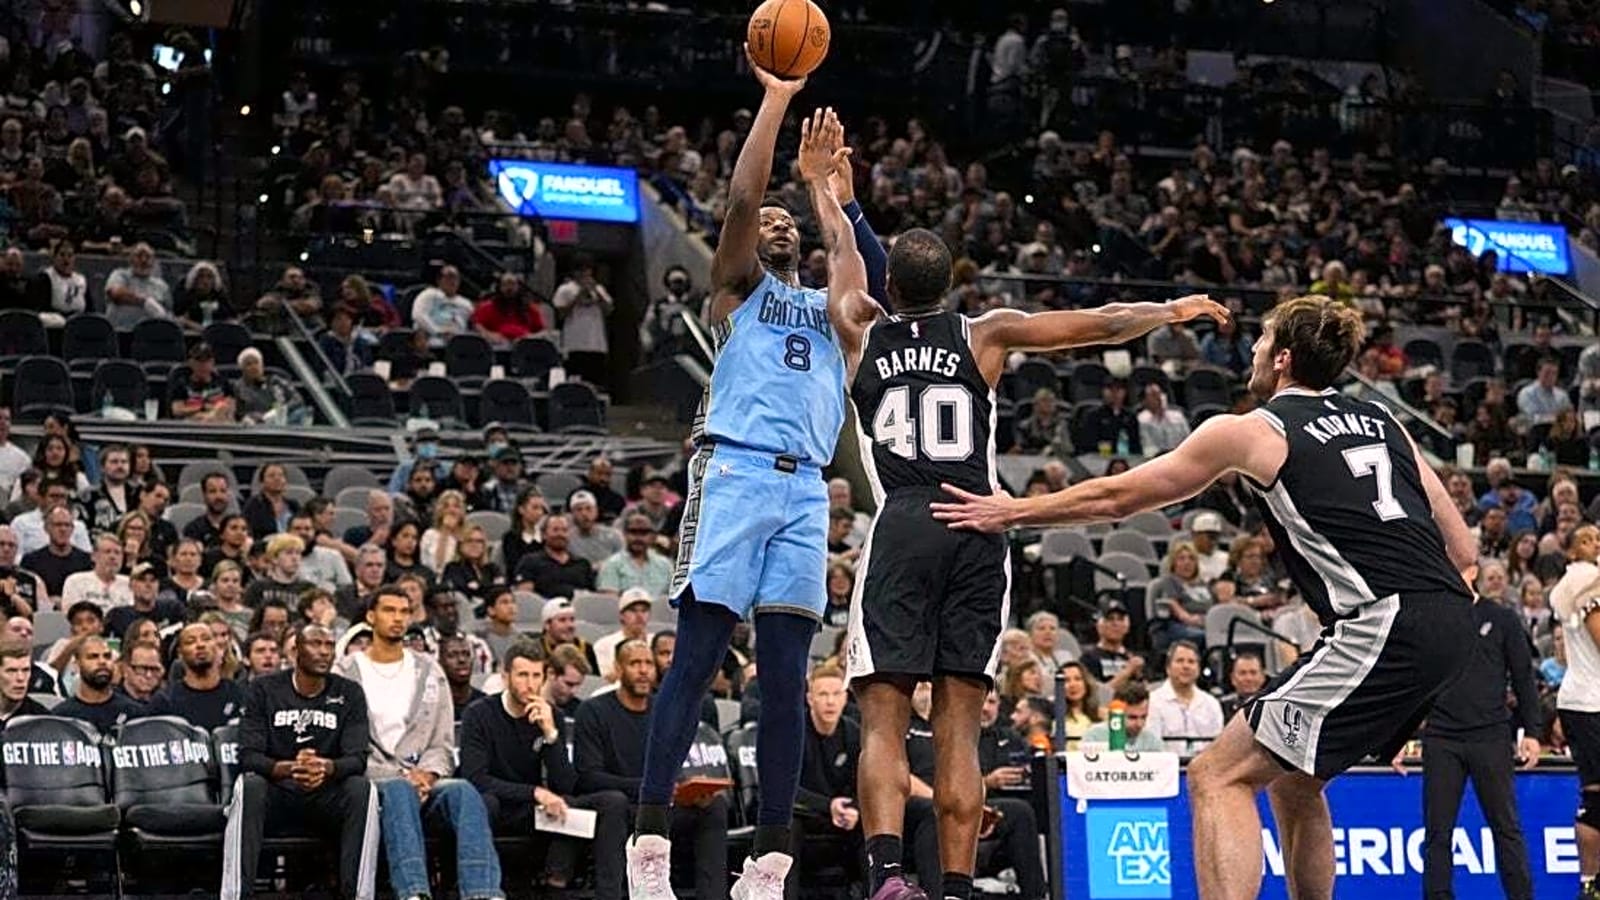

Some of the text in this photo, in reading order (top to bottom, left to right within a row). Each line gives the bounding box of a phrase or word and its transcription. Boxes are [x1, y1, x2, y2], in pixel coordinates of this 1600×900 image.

[784, 334, 811, 371] 8
[875, 346, 961, 380] BARNES
[872, 384, 975, 461] 40
[1303, 413, 1385, 445] KORNET
[1341, 443, 1408, 522] 7
[1110, 718, 1122, 730] G
[2, 742, 29, 765] GET
[31, 742, 60, 765] THE
[76, 740, 101, 768] App
[112, 745, 139, 768] GET
[140, 743, 170, 767] THE
[183, 739, 209, 764] App
[220, 743, 239, 764] GE
[1084, 771, 1154, 782] GATORADE
[1107, 822, 1169, 856] AM
[1117, 853, 1171, 885] EX
